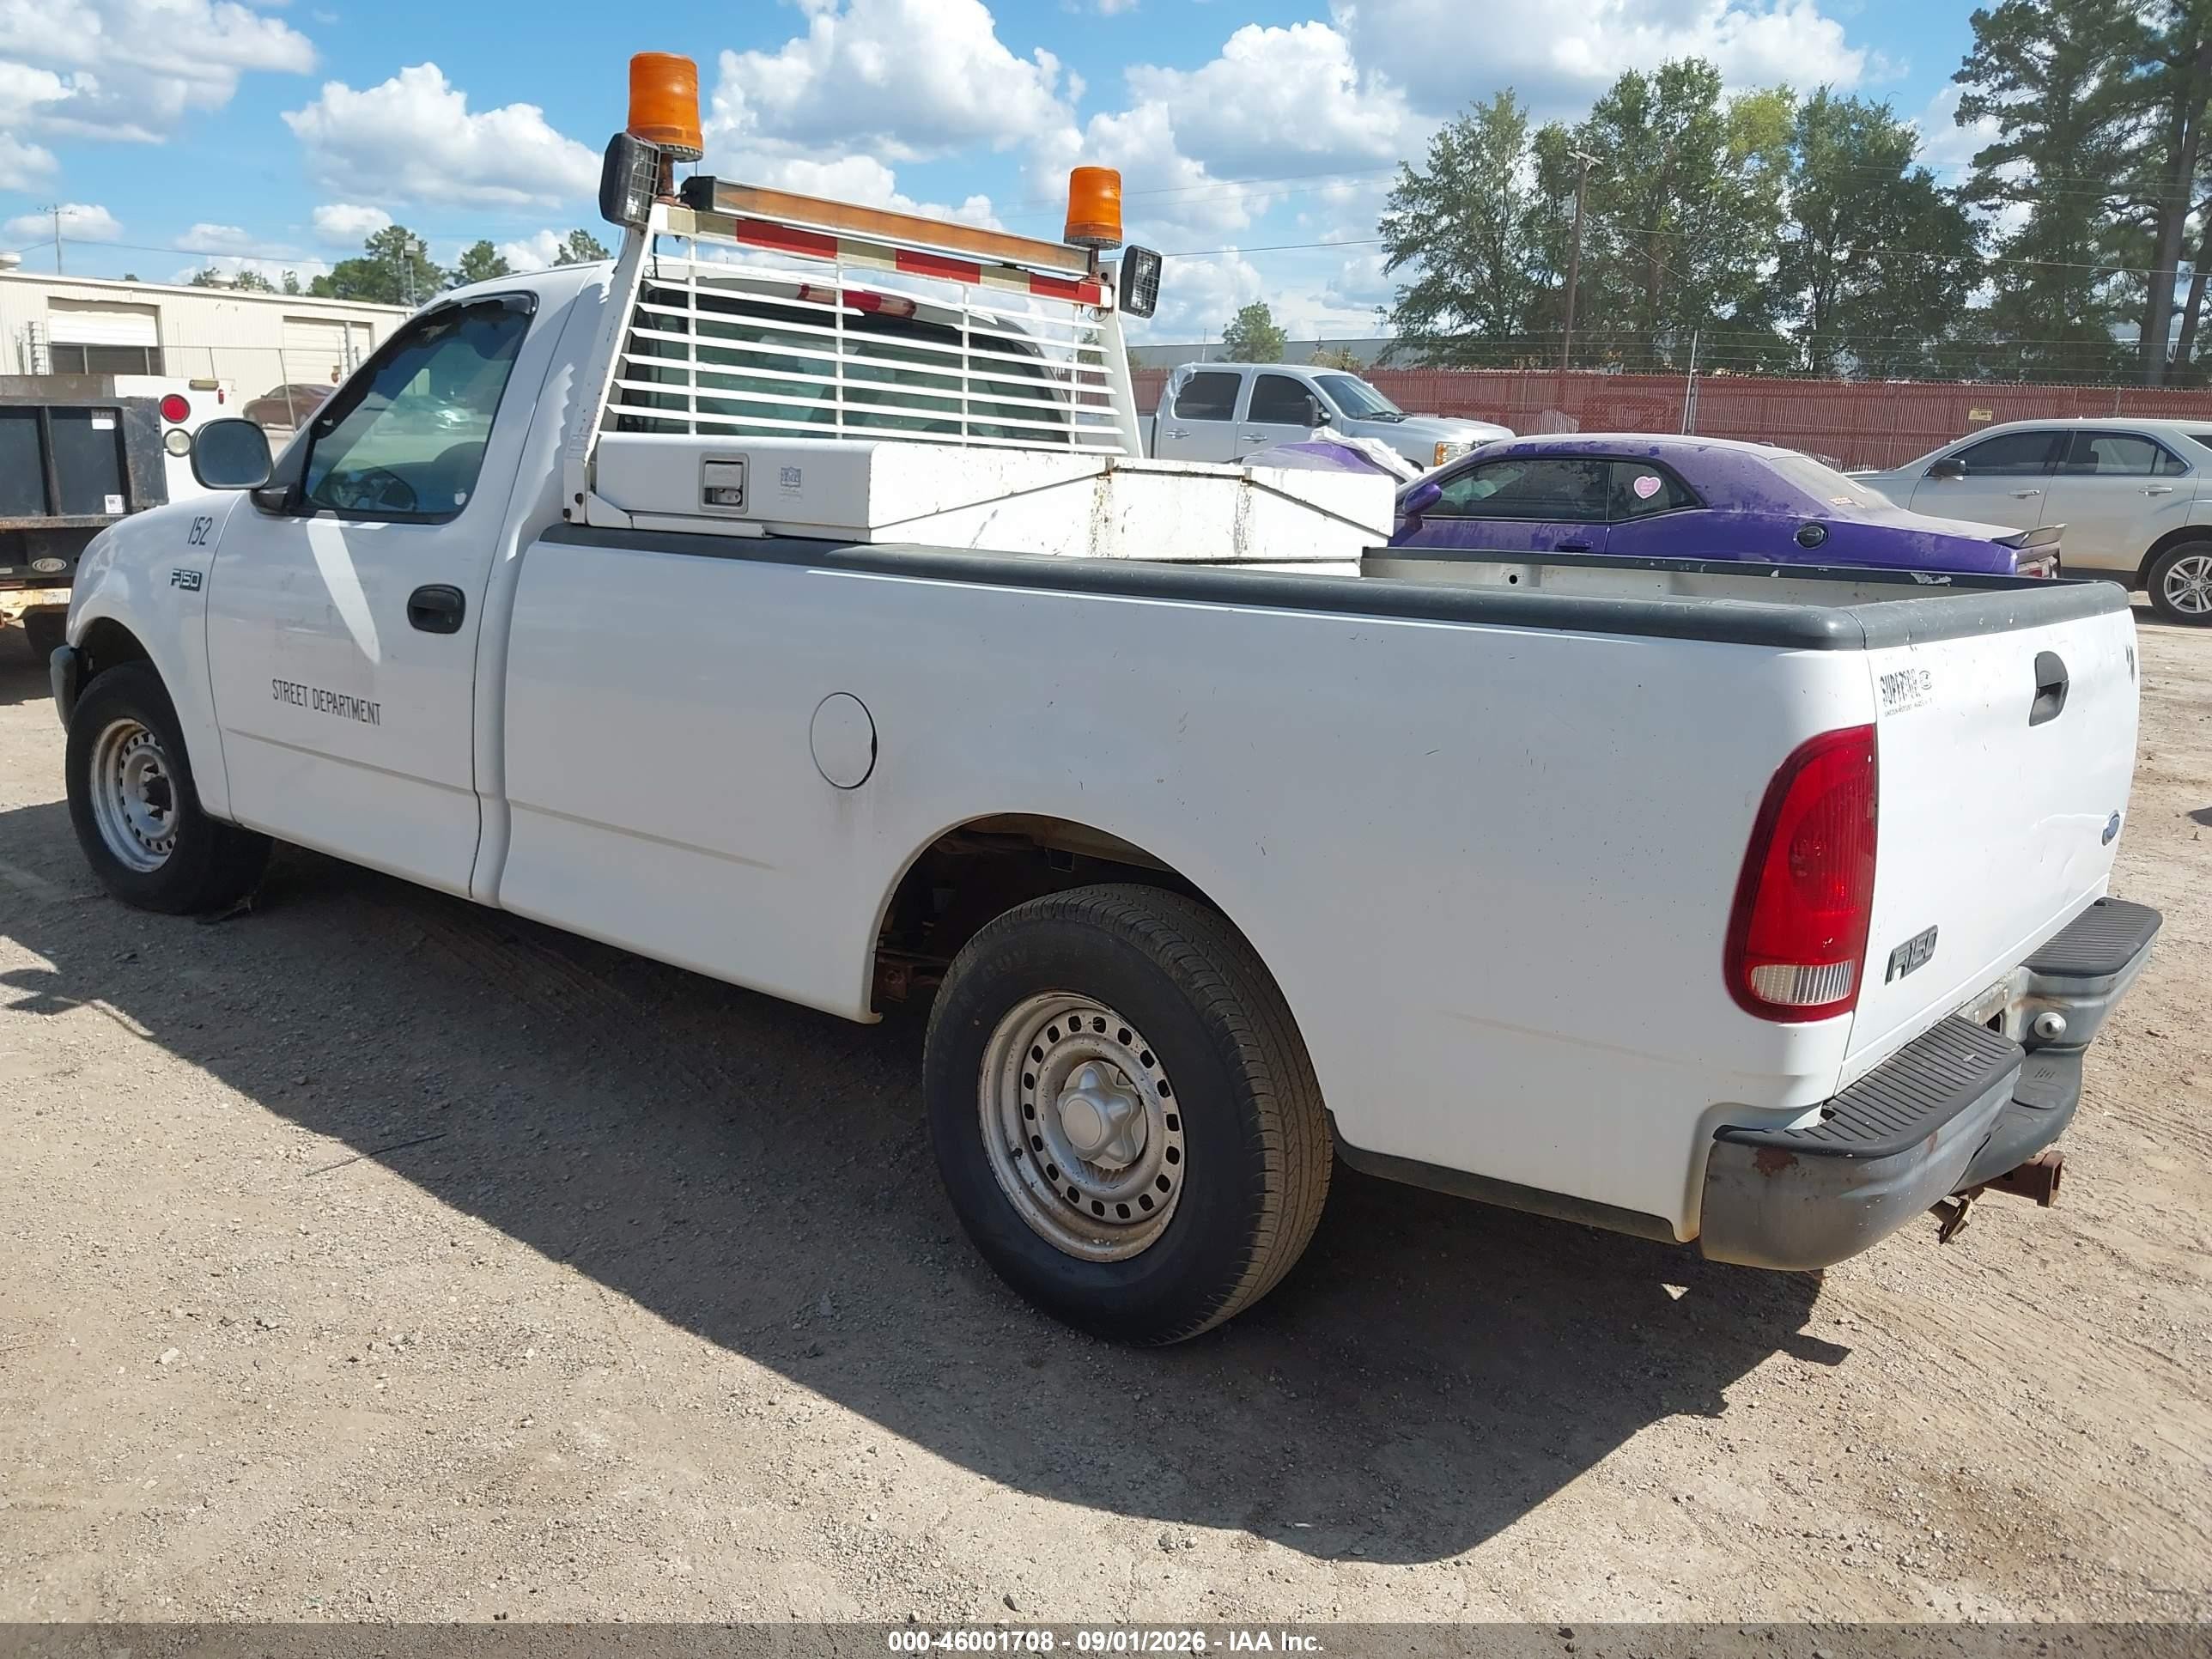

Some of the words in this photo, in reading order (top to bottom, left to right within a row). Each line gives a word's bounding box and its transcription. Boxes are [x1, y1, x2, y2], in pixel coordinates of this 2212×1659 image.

[187, 516, 212, 545] 152
[272, 678, 307, 708] STREET
[313, 688, 380, 726] DEPARTMENT
